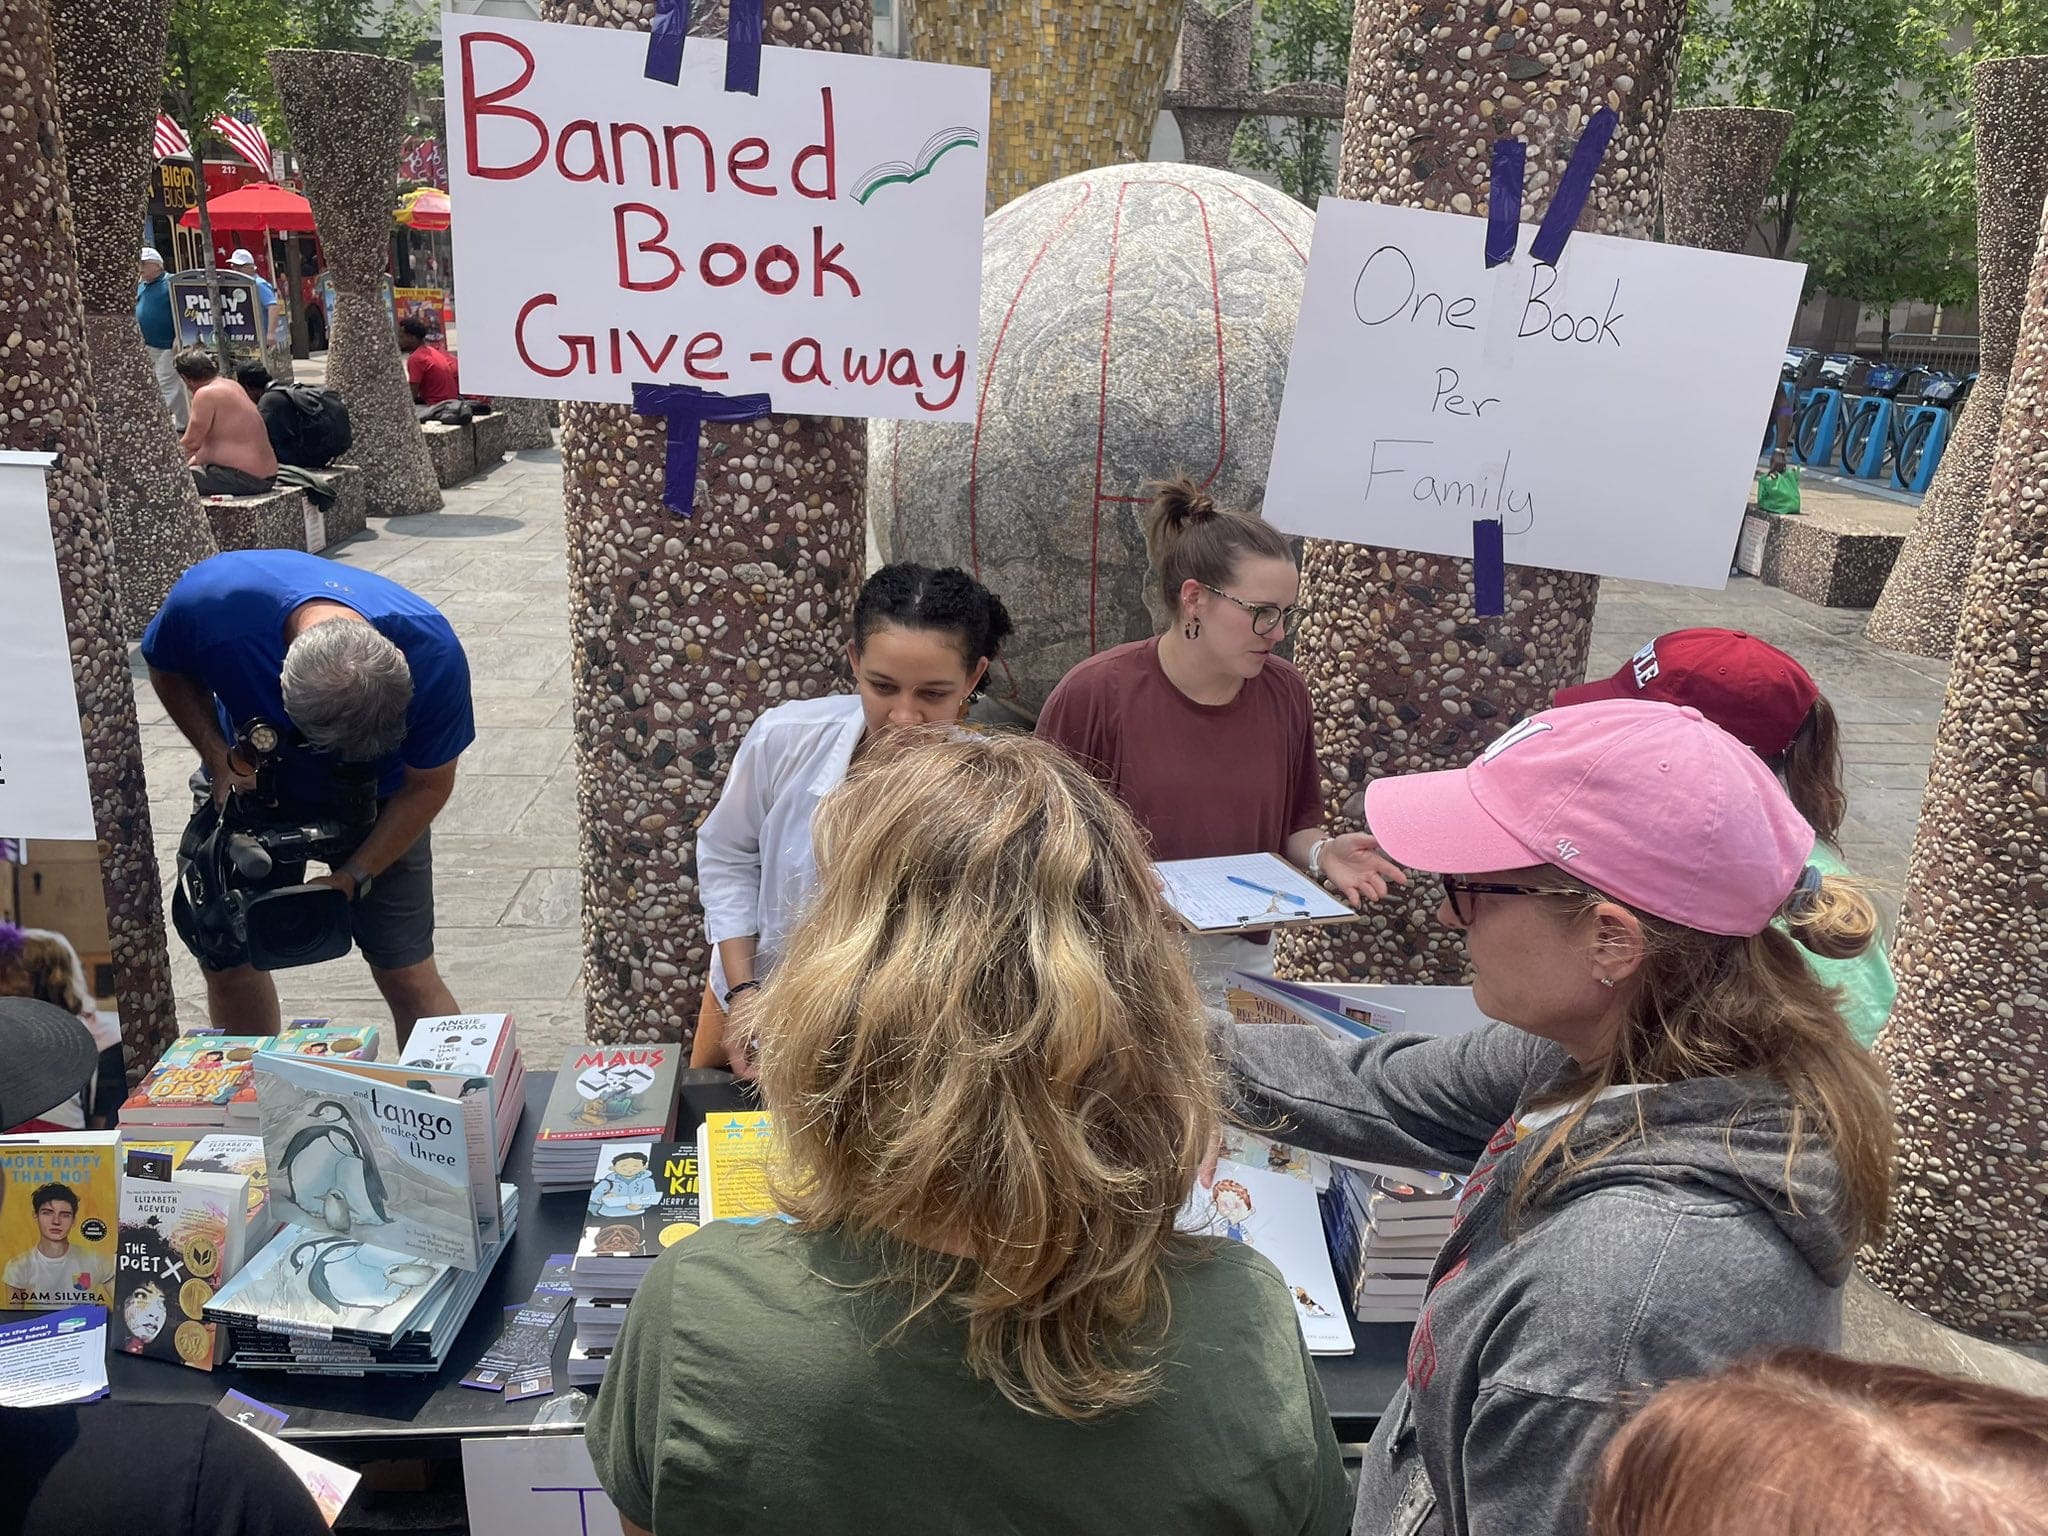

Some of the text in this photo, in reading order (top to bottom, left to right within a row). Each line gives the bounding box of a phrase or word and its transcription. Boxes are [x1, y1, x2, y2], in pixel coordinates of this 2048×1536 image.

[459, 31, 836, 200] Banned
[161, 165, 181, 187] BIG
[221, 165, 237, 174] 212
[164, 187, 184, 208] BUS
[613, 202, 860, 298] Book
[185, 294, 238, 312] Phly
[1353, 245, 1625, 347] One Book
[195, 311, 245, 328] Niht
[1431, 366, 1502, 417] Per
[1364, 439, 1535, 536] Family
[429, 1023, 487, 1033] THOMAS
[438, 1018, 481, 1027] ANGIE
[573, 1049, 666, 1069] MAUS
[156, 1068, 244, 1084] FRONT
[150, 1080, 221, 1097] DESK
[353, 1089, 369, 1099] and
[370, 1088, 452, 1141] tango
[381, 1124, 418, 1141] makes
[0, 1155, 102, 1169] MORE HAPPY
[410, 1142, 457, 1167] three
[12, 1169, 92, 1184] THAN NOT
[663, 1158, 699, 1178] NE
[134, 1195, 178, 1204] ELIZABETH
[660, 1197, 686, 1206] JERRY
[137, 1204, 176, 1214] ACEVEDO
[124, 1242, 147, 1255] THE
[160, 1255, 184, 1284] X
[11, 1291, 105, 1302] ADAM SILVERA
[12, 1328, 27, 1336] the
[29, 1324, 49, 1332] deal
